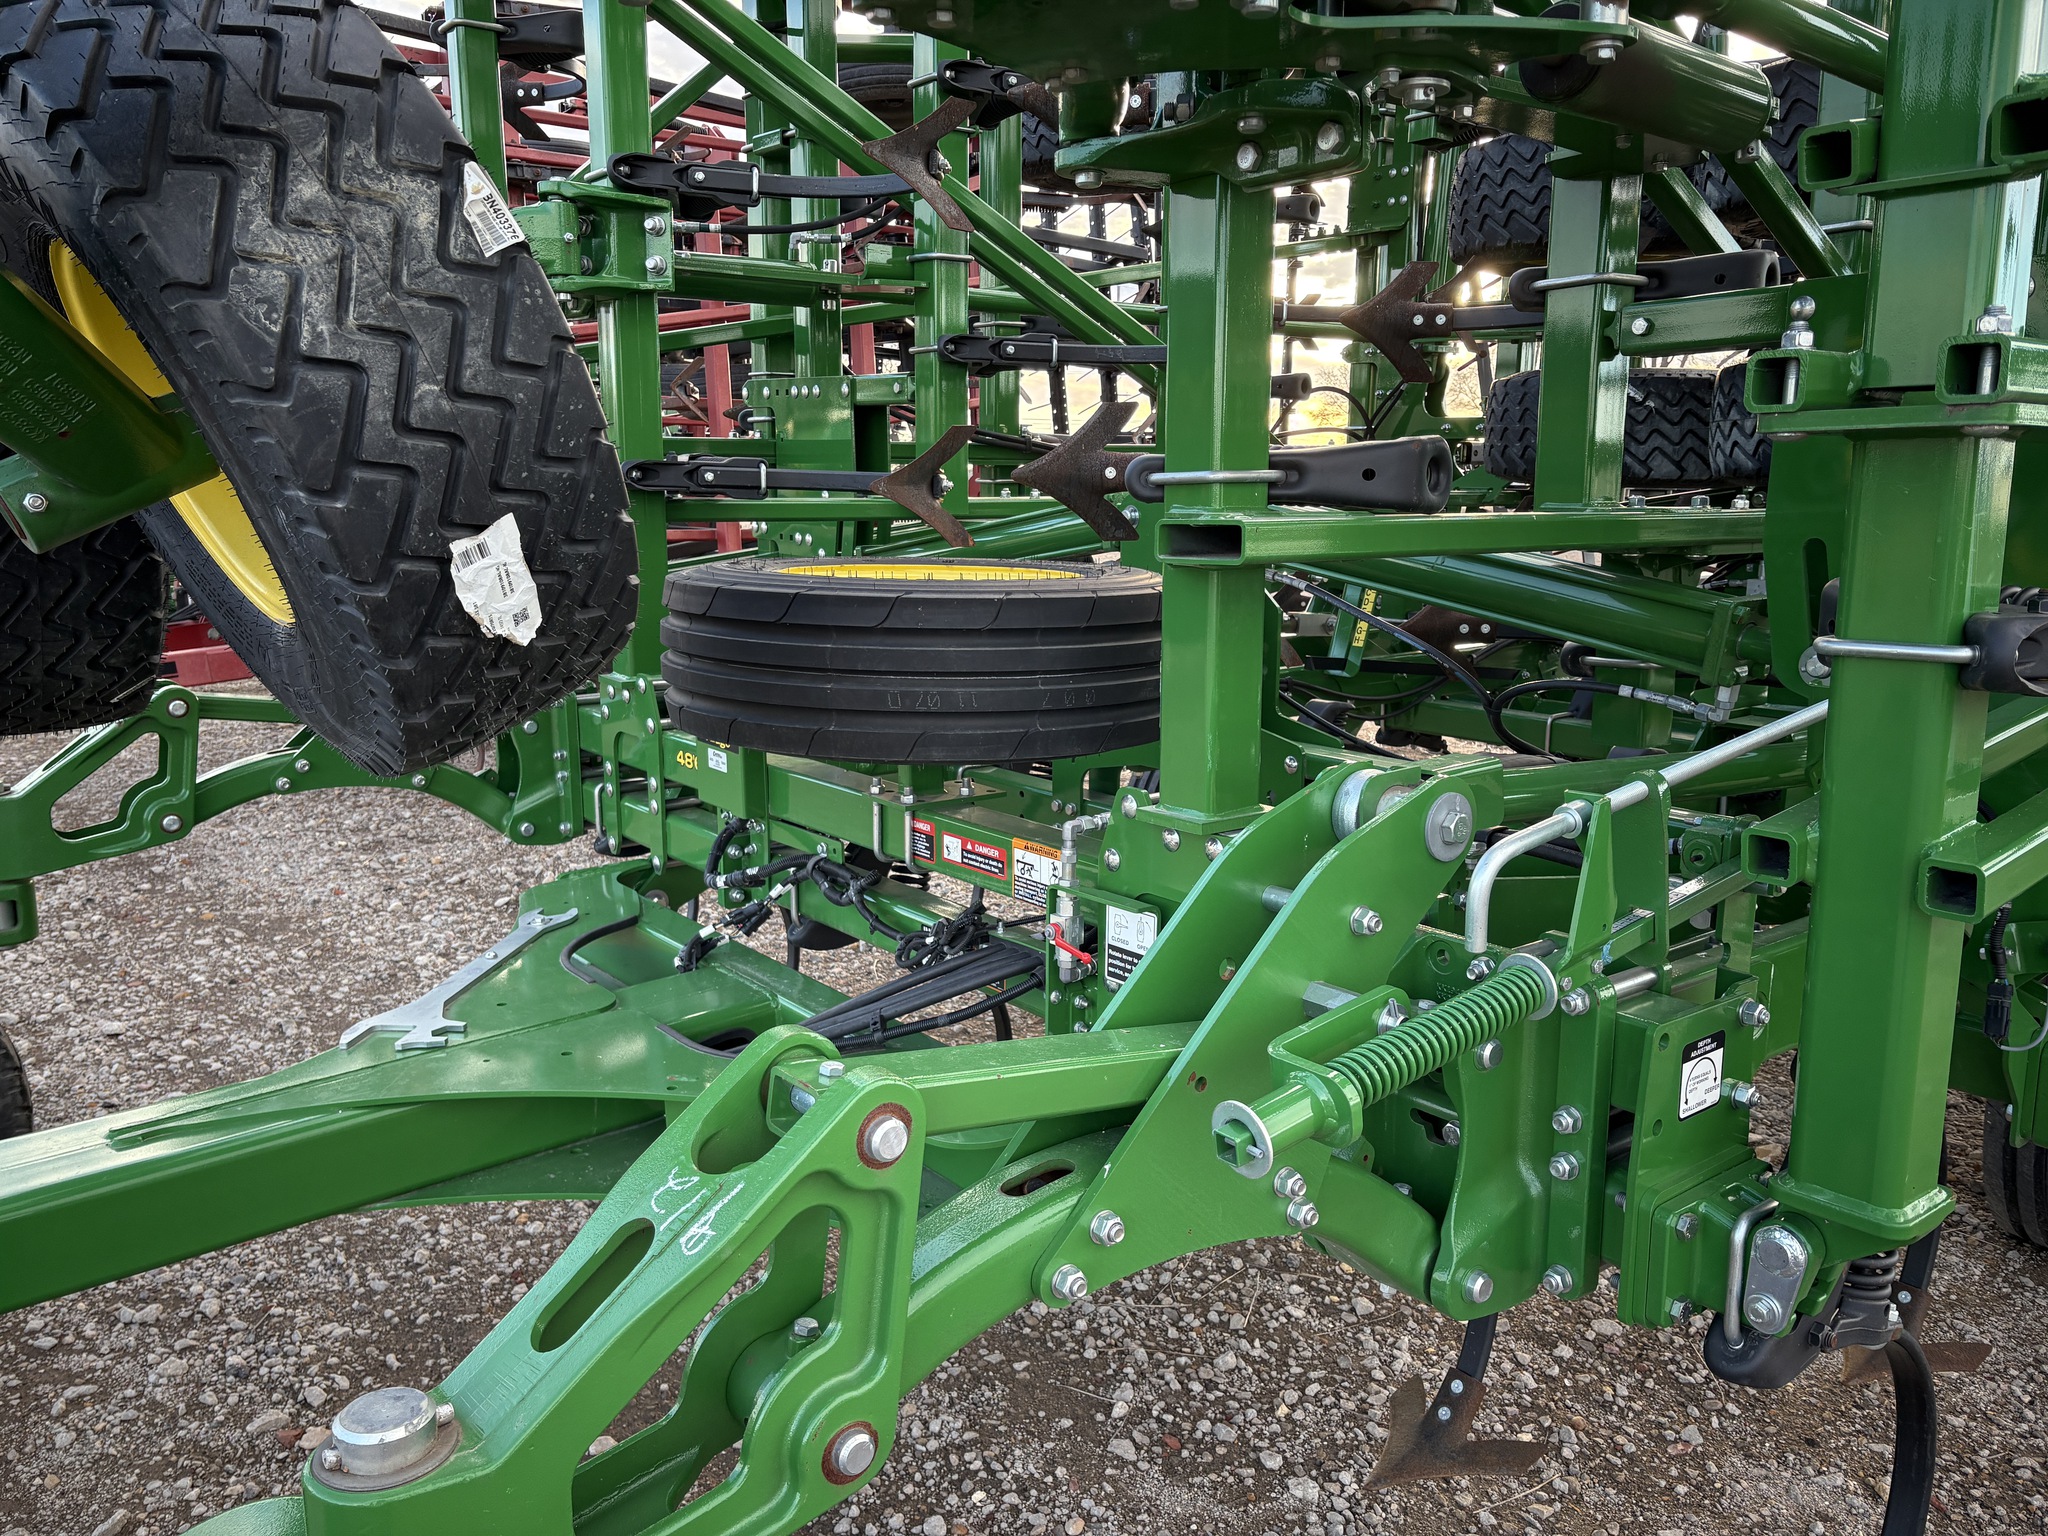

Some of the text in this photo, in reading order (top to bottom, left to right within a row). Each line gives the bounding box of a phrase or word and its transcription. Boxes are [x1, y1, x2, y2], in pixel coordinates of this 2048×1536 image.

[914, 821, 931, 832] DANGER
[975, 844, 999, 858] DANGER
[1030, 843, 1058, 858] WARNING
[1111, 936, 1129, 946] CLOSED
[1109, 949, 1122, 958] Rotate
[1123, 953, 1132, 961] lever
[1109, 959, 1125, 968] position
[1698, 1038, 1711, 1048] DEPTH
[1691, 1042, 1717, 1057] ADJUSTMENT
[1704, 1083, 1720, 1095] DEEPER
[1682, 1099, 1707, 1114] SHALLOWER
